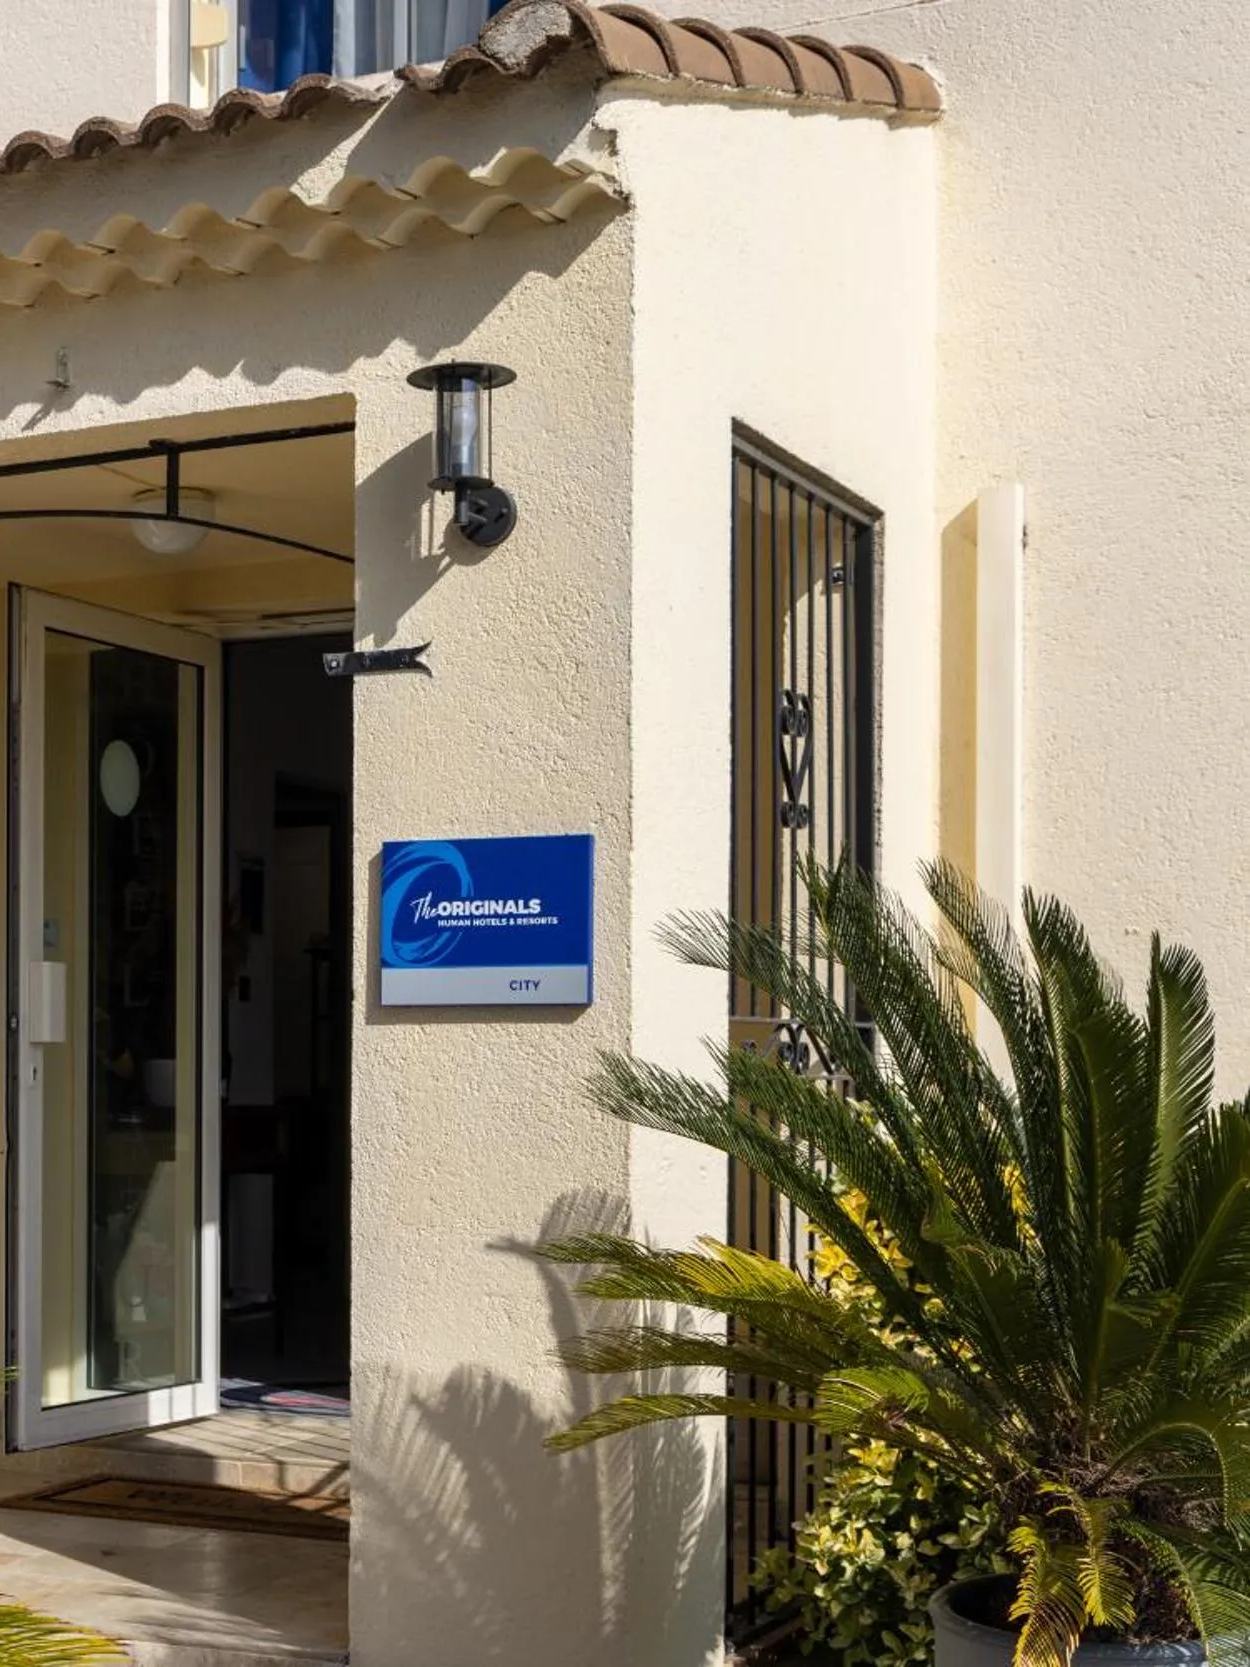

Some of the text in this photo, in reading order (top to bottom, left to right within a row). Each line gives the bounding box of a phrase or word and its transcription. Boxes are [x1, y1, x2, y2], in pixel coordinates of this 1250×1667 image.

[410, 891, 541, 924] The ORIGINALS
[438, 916, 558, 927] HUMAN HOTELS & RESORTS
[509, 979, 541, 991] CITY
